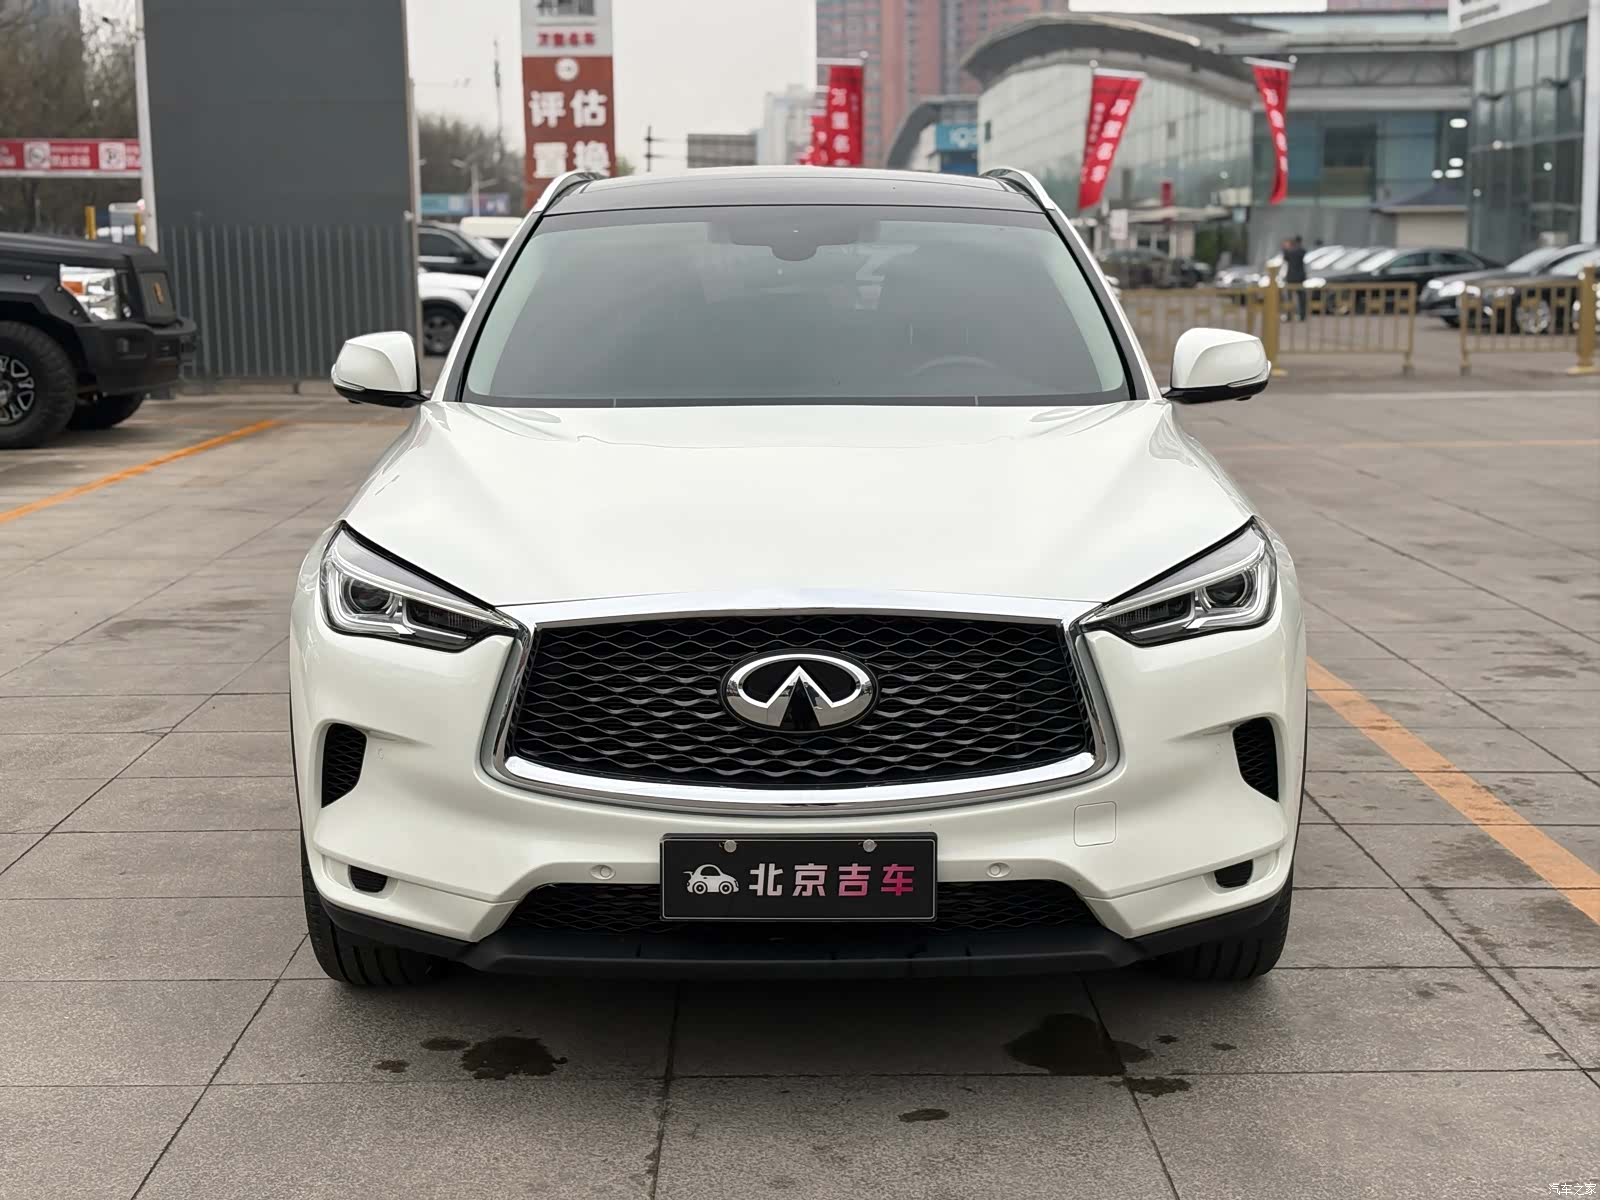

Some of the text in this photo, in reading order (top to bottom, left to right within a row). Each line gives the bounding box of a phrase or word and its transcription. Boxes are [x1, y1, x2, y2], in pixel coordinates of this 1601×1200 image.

[528, 89, 608, 128] 评估
[533, 140, 610, 178] 置换
[749, 863, 915, 897] 北京吉车
